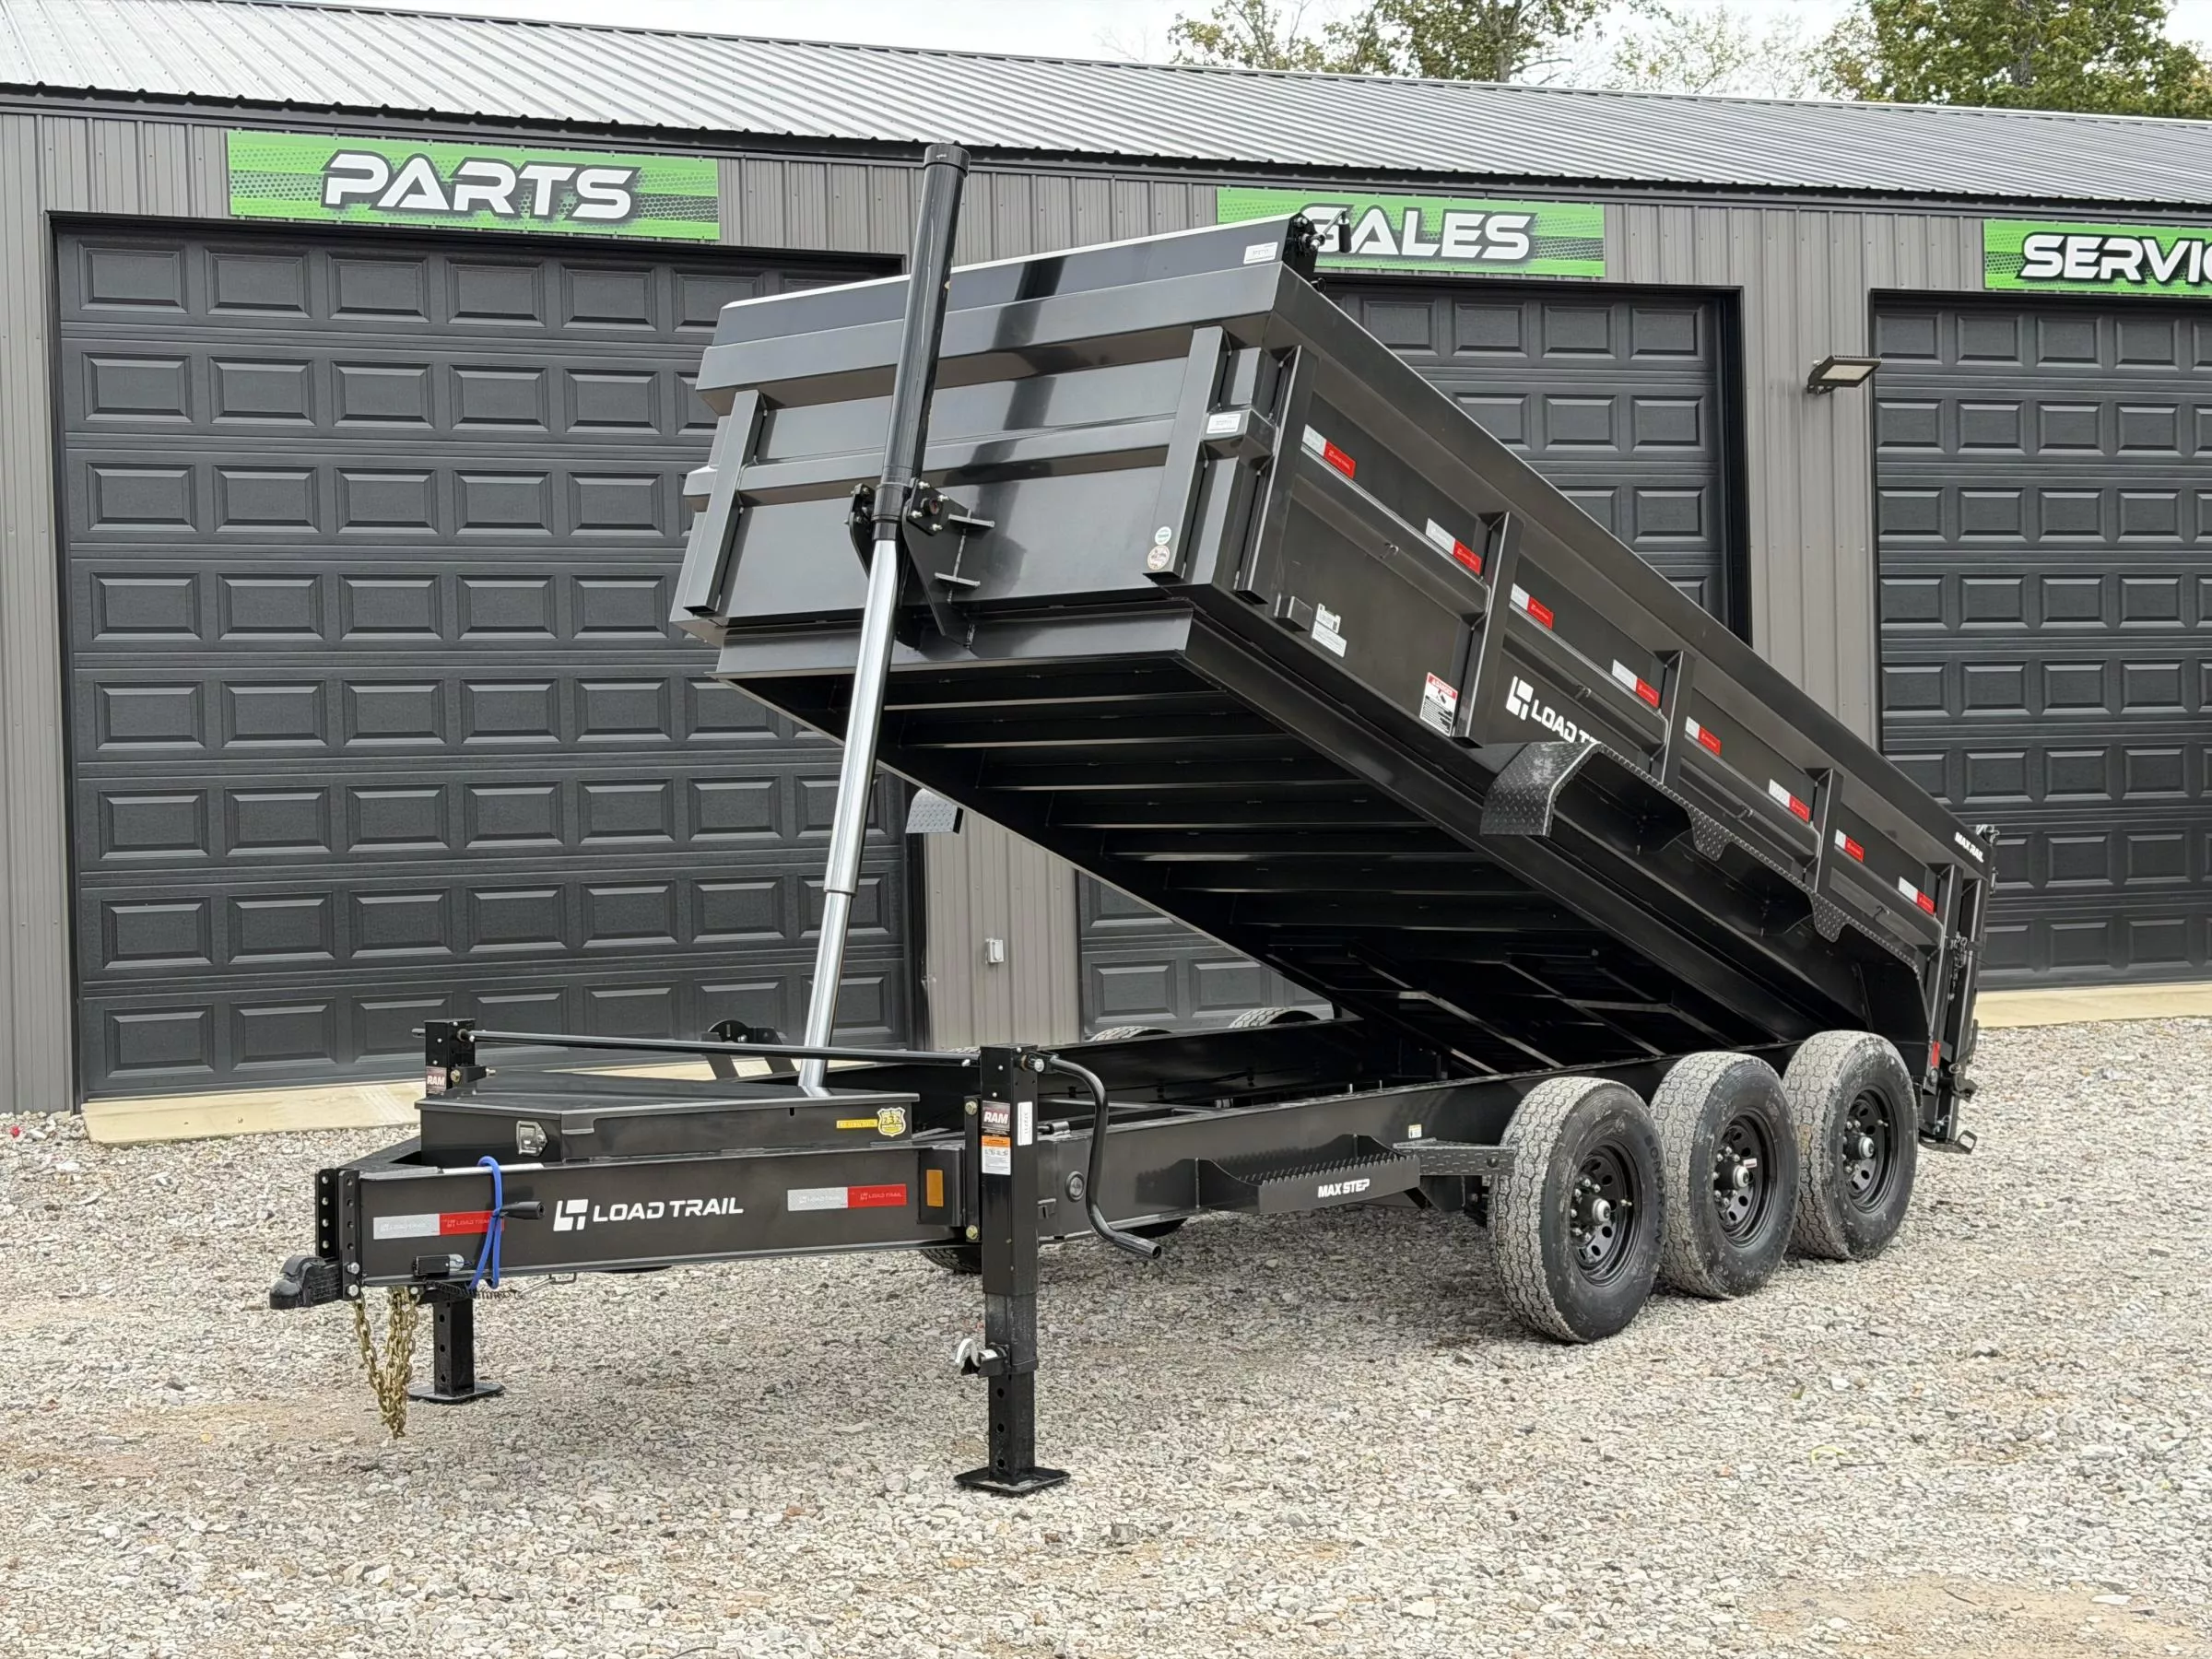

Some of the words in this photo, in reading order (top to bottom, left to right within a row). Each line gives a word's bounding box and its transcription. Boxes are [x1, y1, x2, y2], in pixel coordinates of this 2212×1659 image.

[324, 153, 634, 219] PARTS
[2020, 234, 2212, 284] SERVI
[1531, 699, 1577, 743] LOAD
[1954, 831, 1971, 851] MAX
[1969, 843, 1984, 864] RAIL
[427, 1075, 445, 1086] RAM
[983, 1112, 1009, 1124] RAM
[1318, 1183, 1342, 1198] MAX
[1343, 1179, 1370, 1196] STEP
[593, 1201, 665, 1222] LOAD
[669, 1198, 744, 1217] TRAIL
